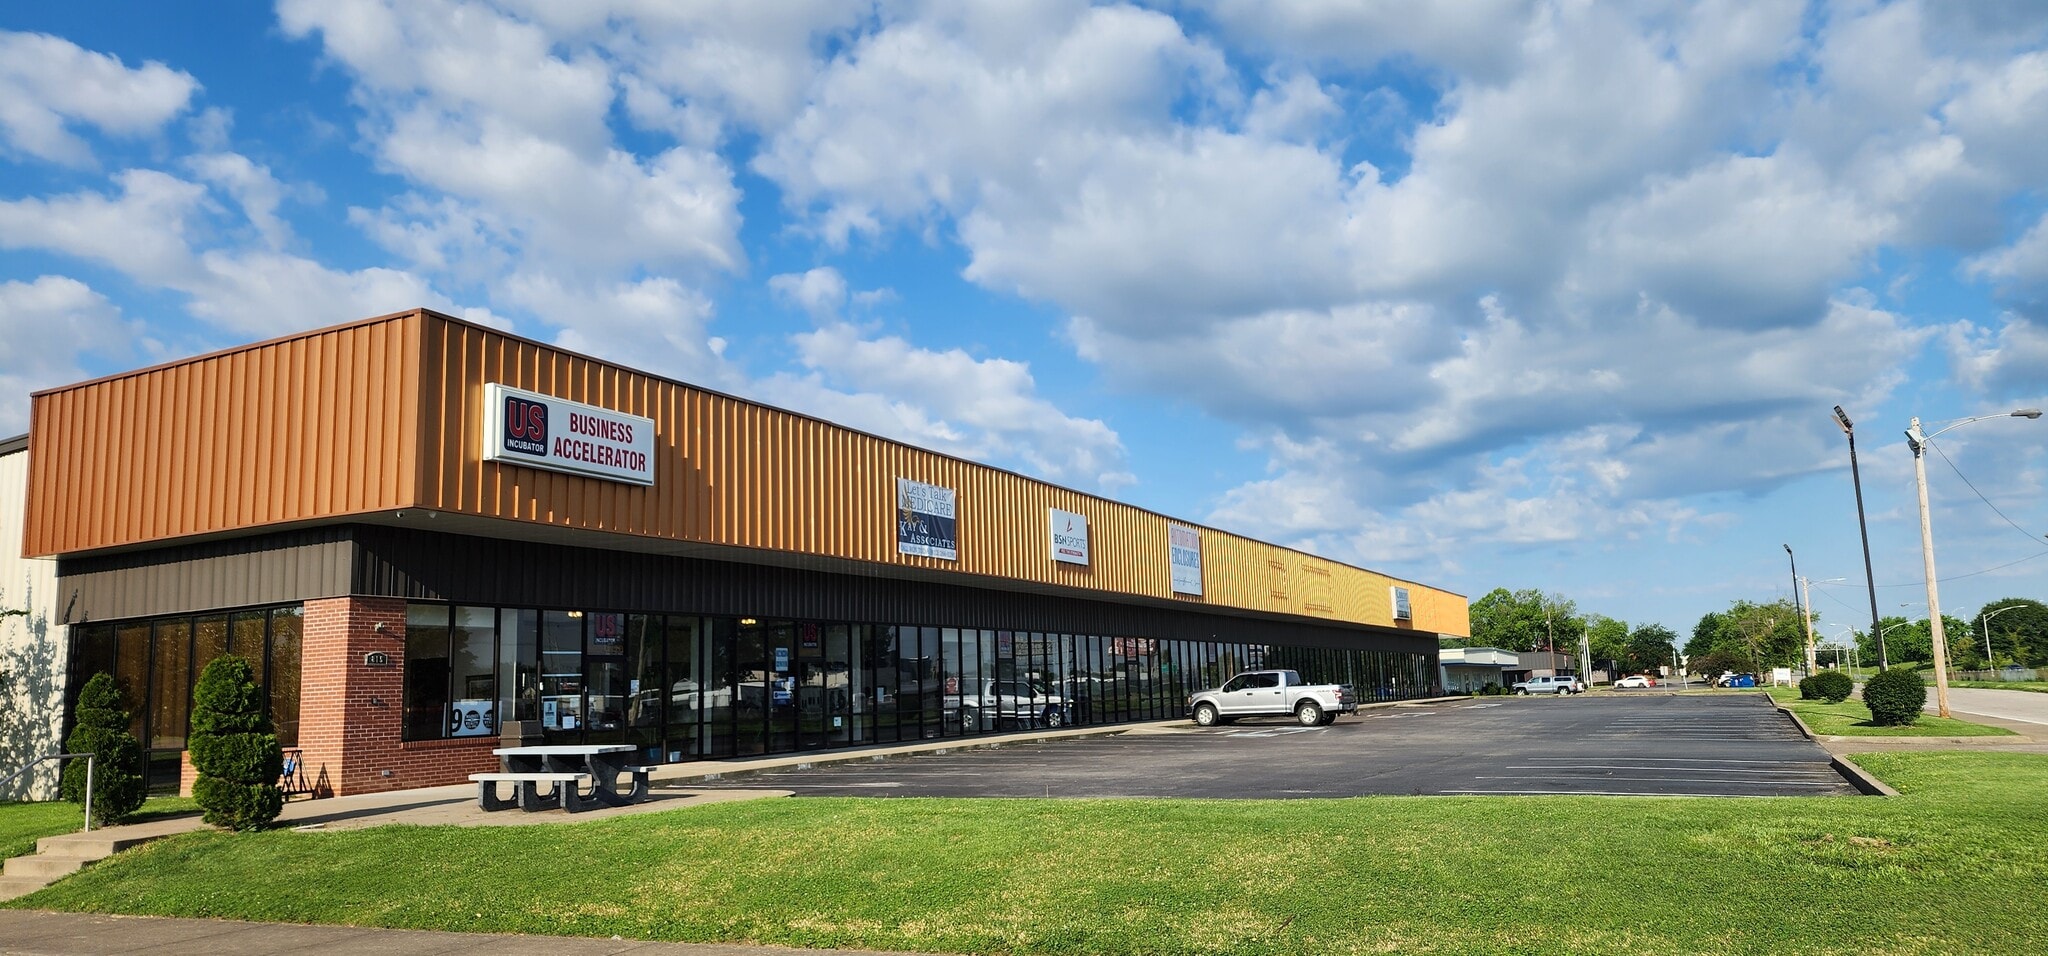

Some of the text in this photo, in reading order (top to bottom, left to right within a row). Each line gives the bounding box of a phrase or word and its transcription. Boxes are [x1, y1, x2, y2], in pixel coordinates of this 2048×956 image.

[508, 400, 545, 441] US
[570, 412, 633, 444] BUSINESS
[507, 438, 544, 453] INCUBATOR
[553, 436, 646, 472] ACCELERATOR
[907, 481, 946, 502] Let's Talk
[919, 520, 928, 534] &
[1067, 536, 1085, 549] SPORTS
